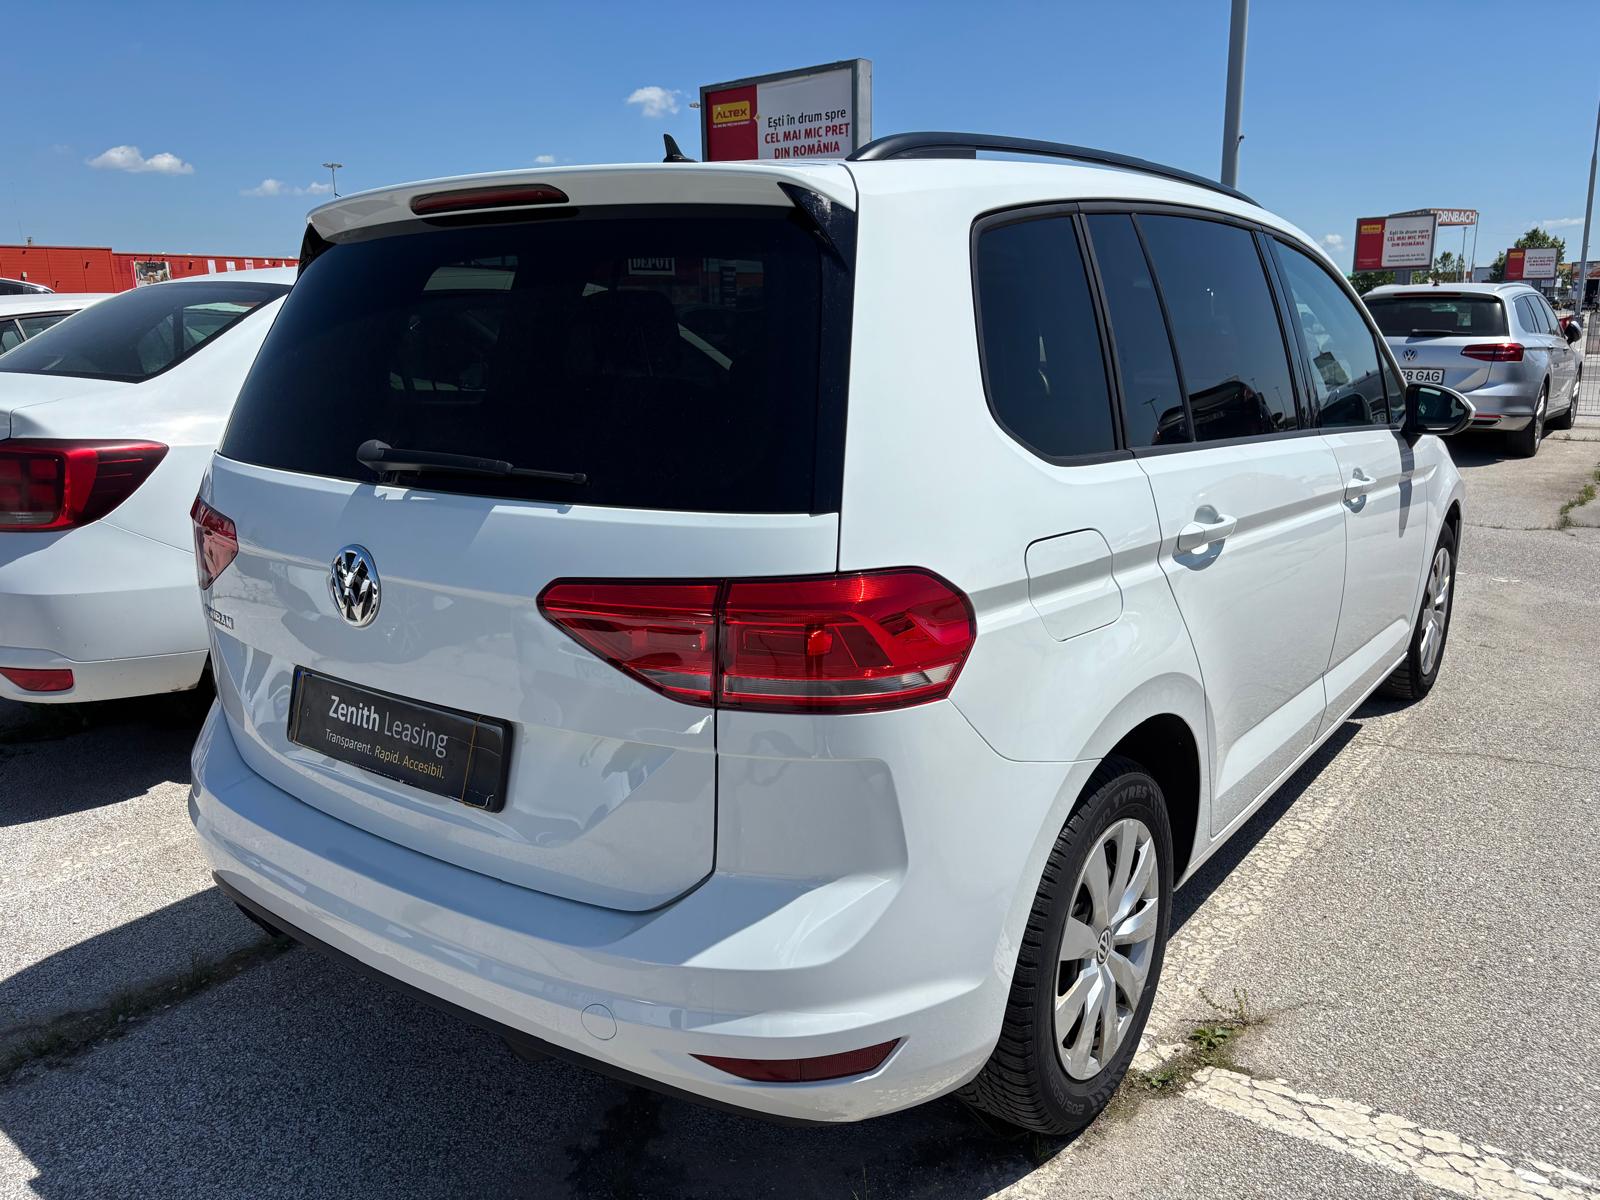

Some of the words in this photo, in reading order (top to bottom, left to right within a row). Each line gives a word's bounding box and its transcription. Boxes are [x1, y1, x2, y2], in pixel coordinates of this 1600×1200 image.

[787, 114, 796, 125] în
[798, 112, 822, 124] drum
[825, 108, 847, 121] spre
[764, 131, 781, 144] CEL
[783, 129, 801, 142] MAI
[804, 126, 823, 139] MIC
[774, 145, 790, 159] DIN
[793, 140, 840, 157] ROMÂNIA
[1416, 371, 1440, 382] GAG
[328, 695, 380, 732] Zenith
[384, 711, 449, 758] Leasing
[325, 728, 372, 755] Transparent.
[374, 744, 401, 765] Rapid.
[402, 754, 445, 780] Accesibil.
